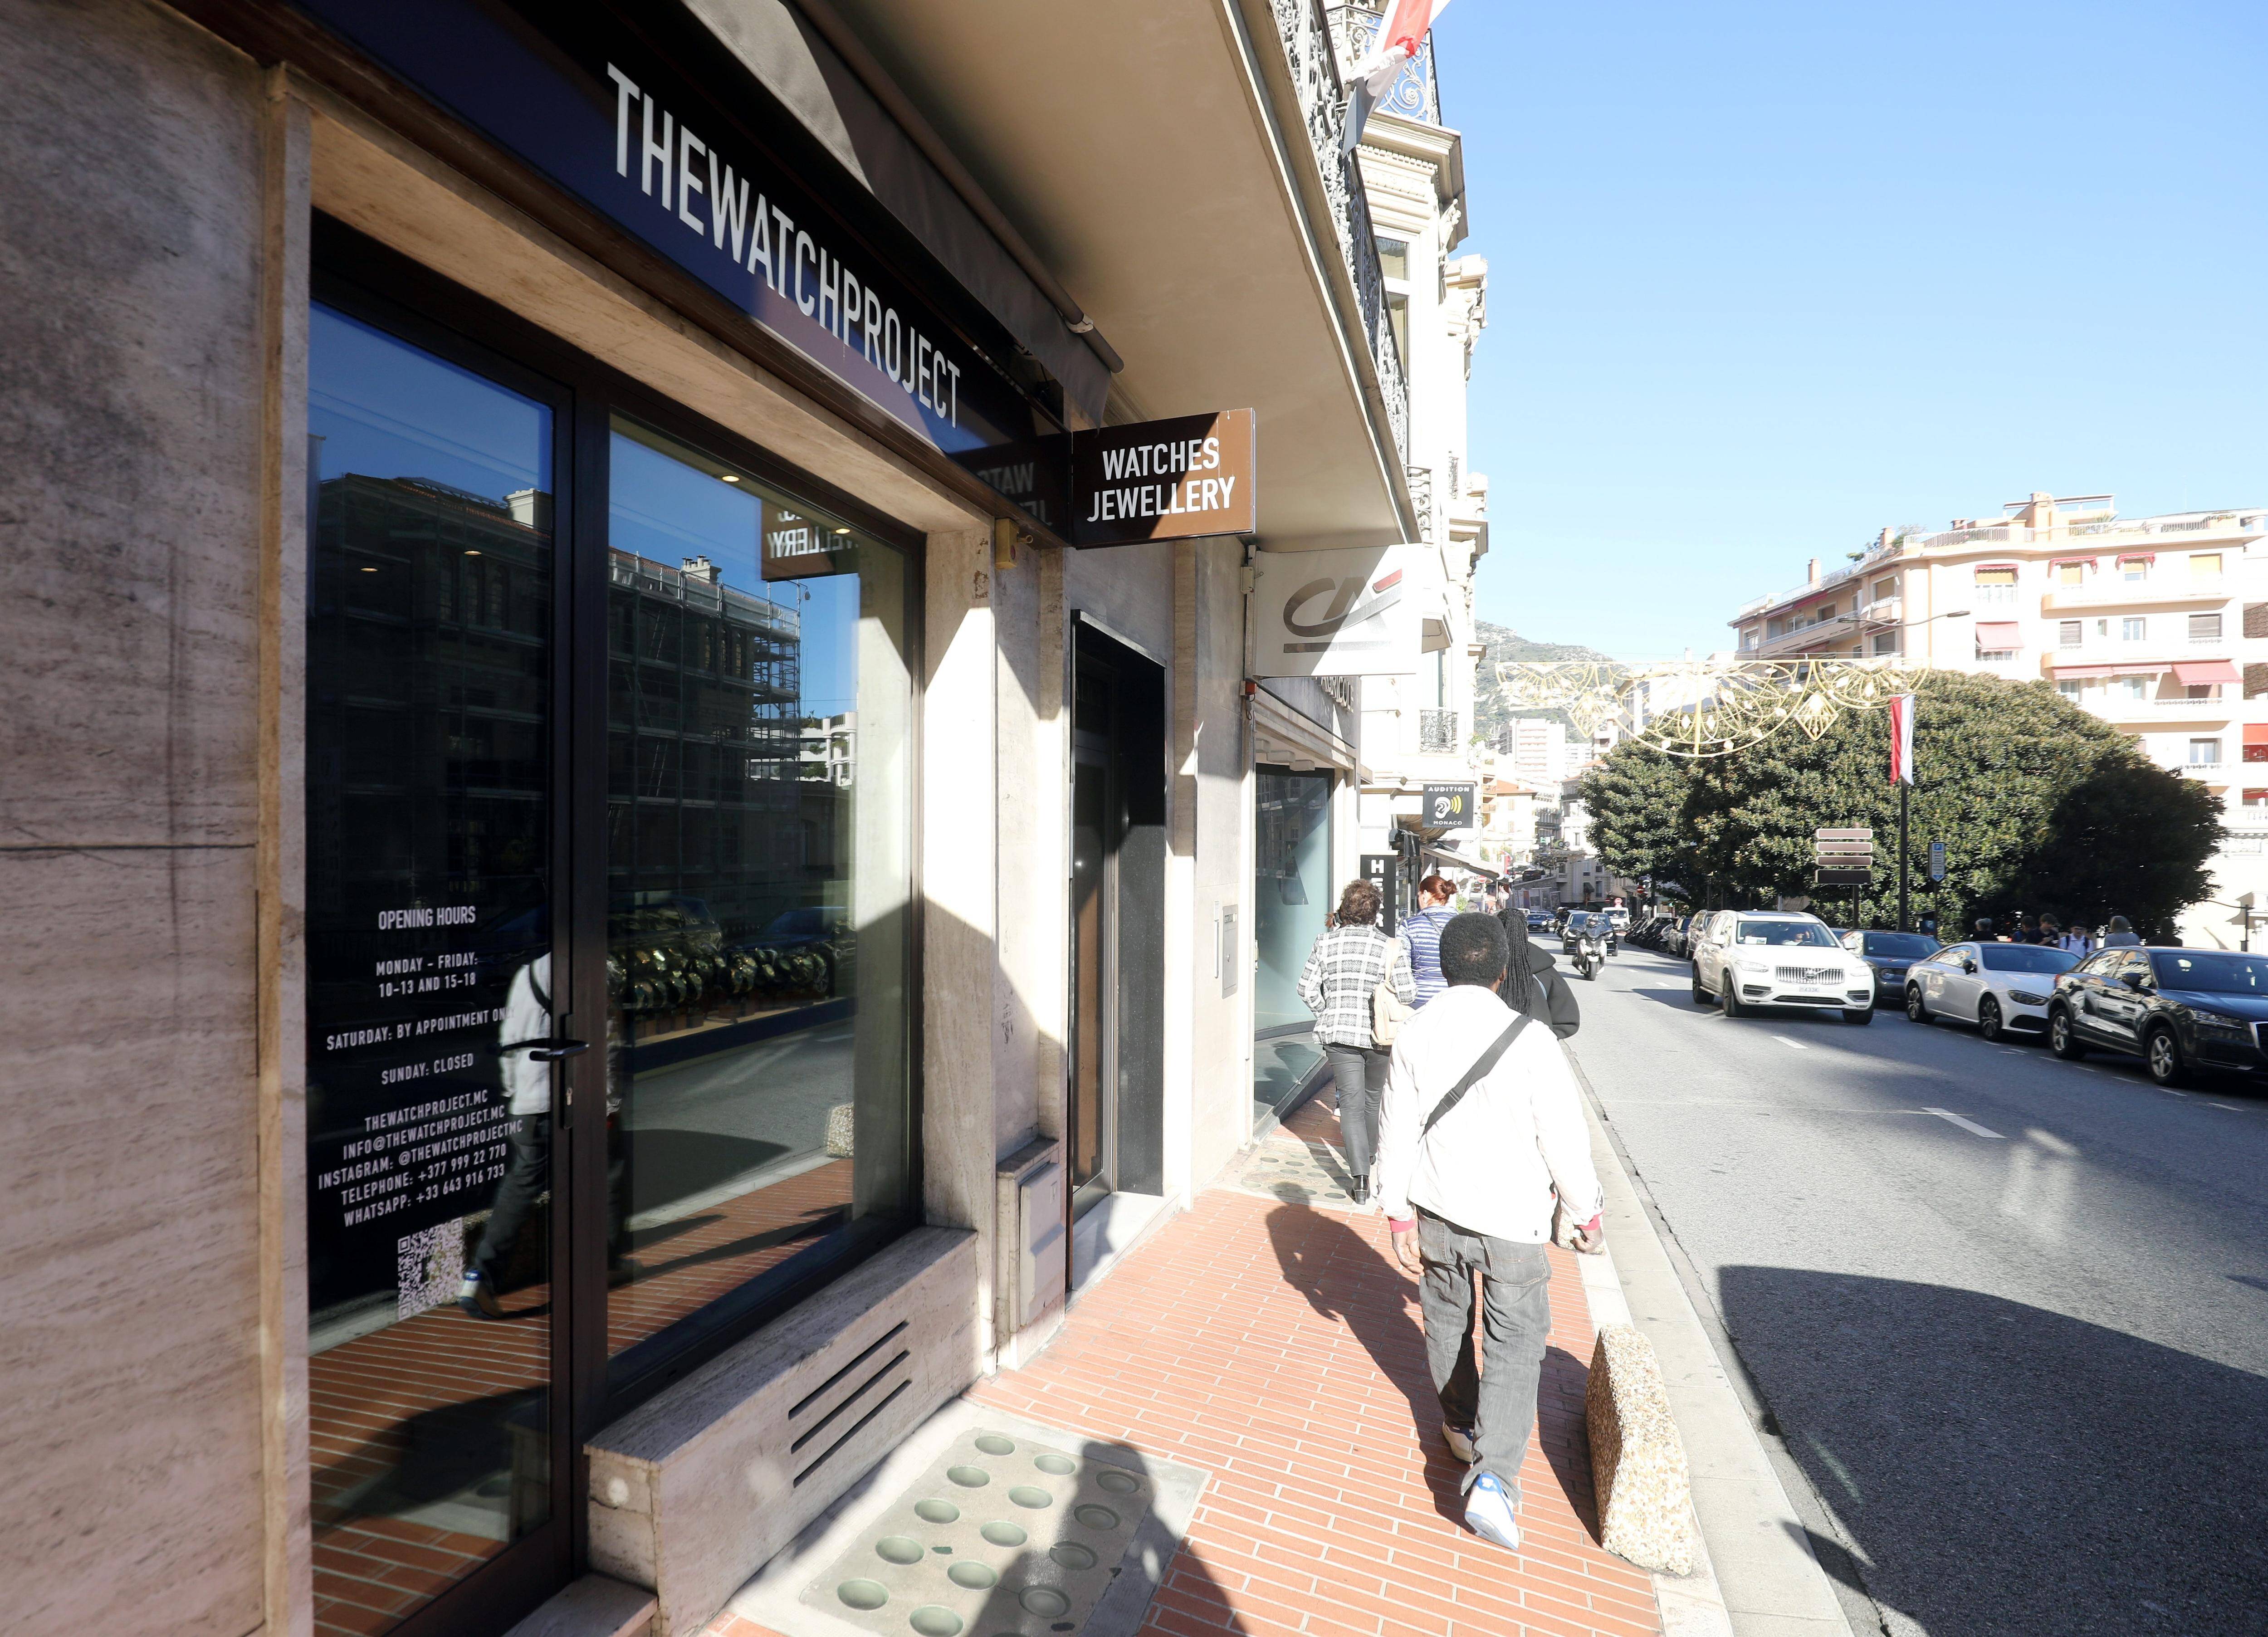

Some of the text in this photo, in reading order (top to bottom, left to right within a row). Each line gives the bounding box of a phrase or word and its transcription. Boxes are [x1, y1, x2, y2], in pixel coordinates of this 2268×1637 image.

[607, 62, 960, 428] THEWATCHPROJECT
[1102, 437, 1220, 481] WATCHES
[1086, 476, 1236, 522] JEWELLERY
[379, 905, 476, 930] OPENING HOURS
[376, 957, 422, 976] MONDAY
[438, 952, 478, 970] FRIDAY:
[379, 972, 476, 997] 10-13 AND 15-18
[327, 1026, 392, 1050] SATURDAY:
[397, 1020, 411, 1038] BY
[415, 1008, 488, 1036] APPOINTMENT
[381, 1053, 474, 1085] SUNDAY: CLOSED
[343, 1105, 505, 1160] INFO@THEWATCHPROJECT.MC
[365, 1090, 488, 1132] THEWATCHPROJECT.MC
[318, 1120, 523, 1190] INSTAGRAM: @THEWATCHPROJECTMC
[341, 1143, 506, 1206] TELEPHONE: +377 999 22 770
[344, 1163, 505, 1227] WHATSAPP: +33 643 916 733
